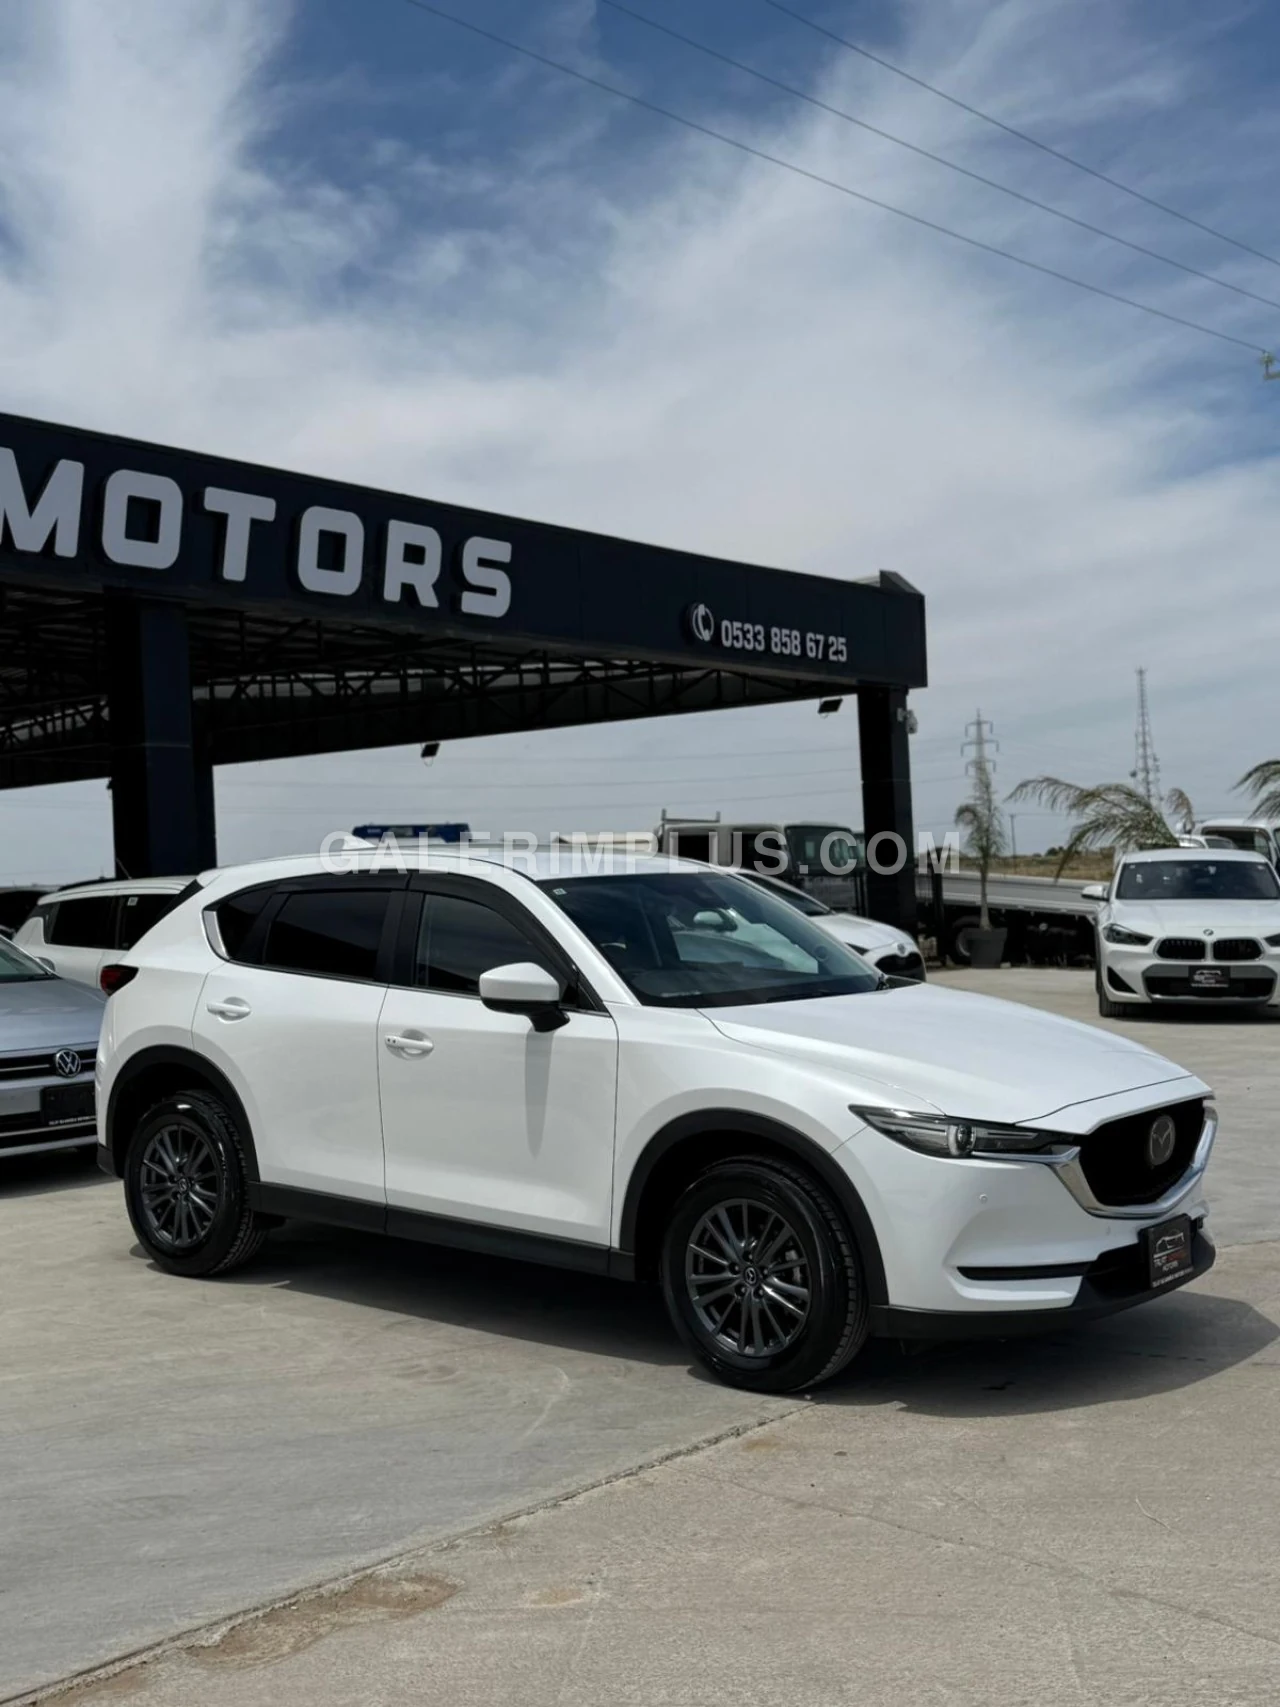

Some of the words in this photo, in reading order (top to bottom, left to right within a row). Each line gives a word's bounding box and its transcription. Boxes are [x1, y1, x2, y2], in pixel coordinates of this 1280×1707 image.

[0, 446, 513, 618] MOTORS
[721, 619, 765, 651] 0533
[770, 626, 801, 656] 858
[805, 632, 825, 660] 67
[827, 635, 848, 662] 25
